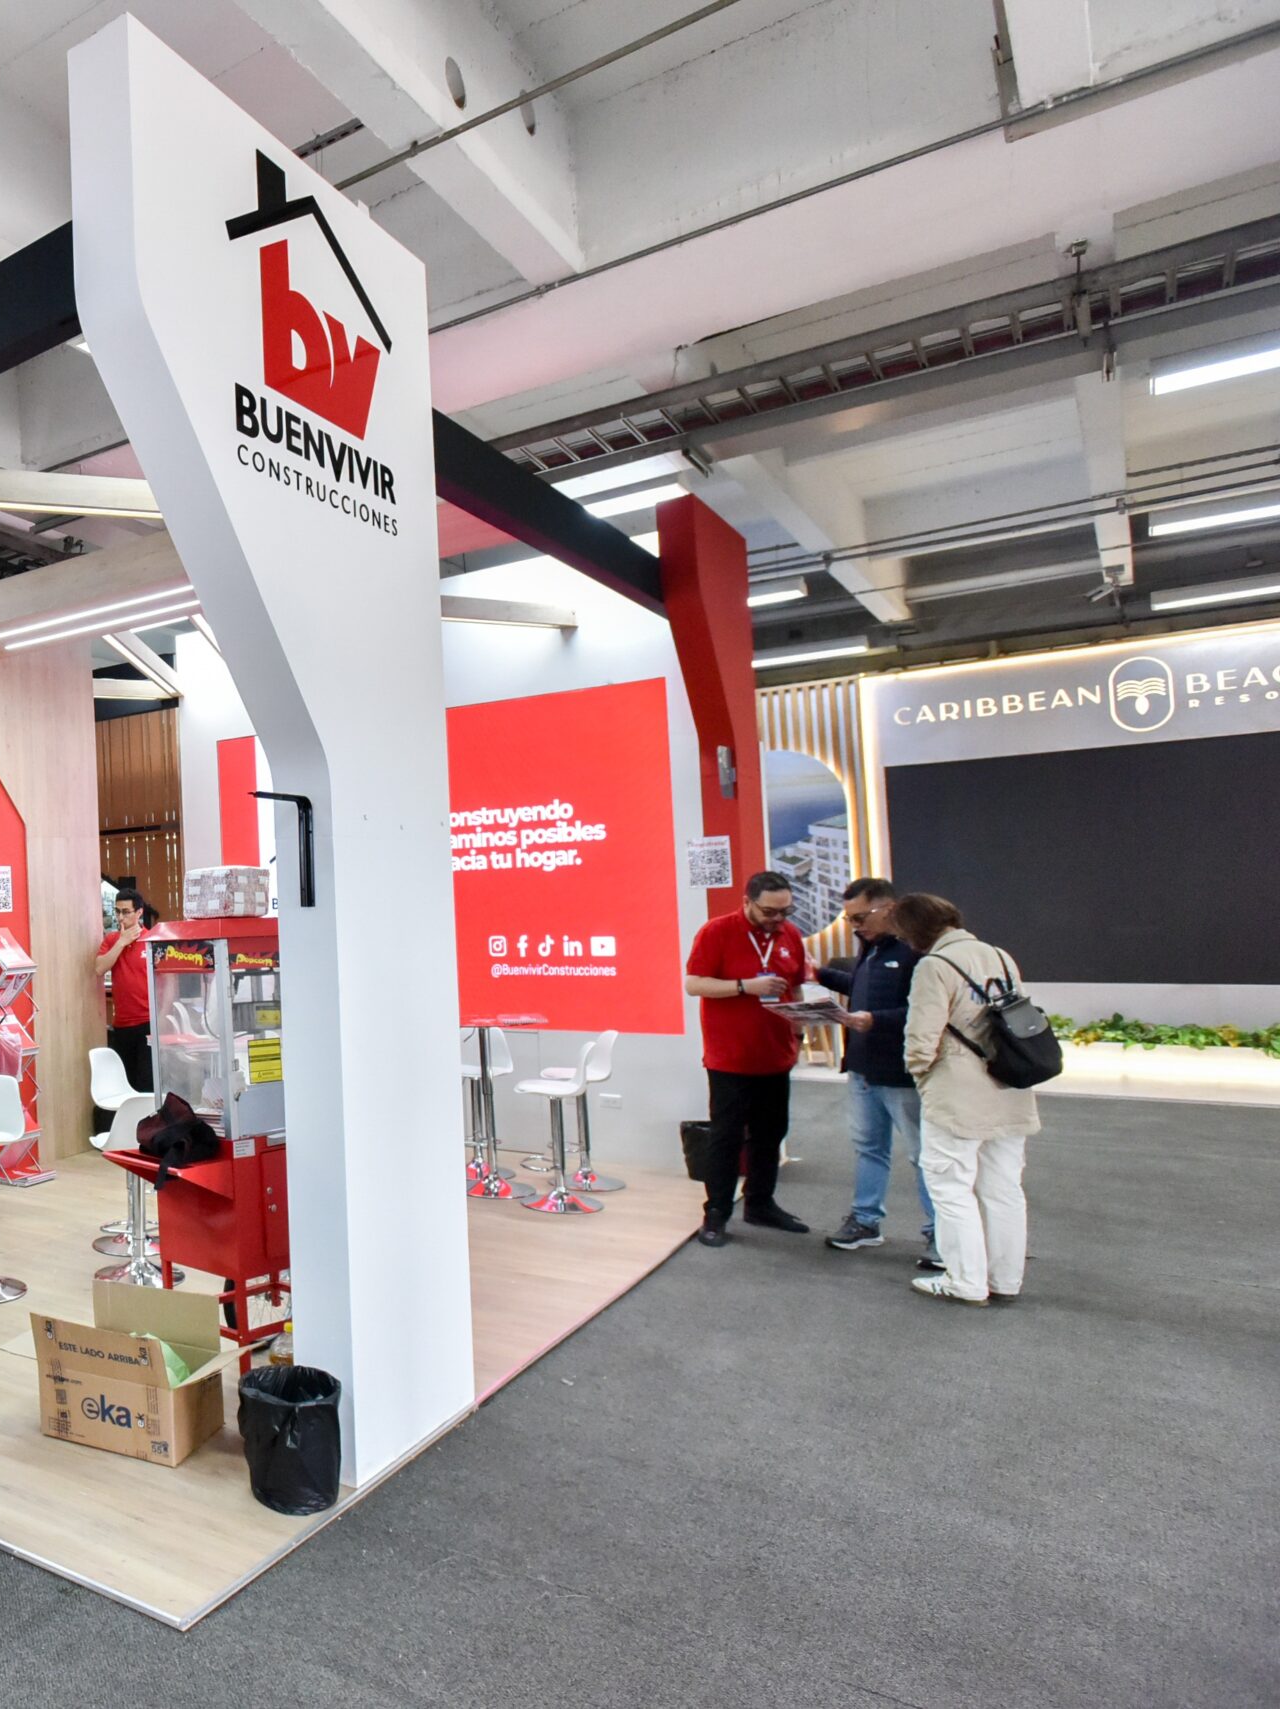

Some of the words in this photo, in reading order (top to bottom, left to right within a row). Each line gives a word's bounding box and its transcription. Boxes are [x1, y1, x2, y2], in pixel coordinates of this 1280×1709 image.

[234, 382, 397, 505] BUENVIVIR
[237, 444, 399, 537] CONSTRUCCIONES
[893, 684, 1102, 726] CARIBBEAN
[449, 799, 574, 828] onstruyendo
[450, 826, 518, 849] aminos
[520, 820, 607, 850] posibles
[451, 849, 488, 871] acia
[490, 851, 513, 870] tu
[516, 848, 583, 872] hogar.
[165, 944, 204, 967] Popcorn
[491, 963, 617, 978] @BuenvivirConstrucciones
[58, 1341, 78, 1353] ESTE
[80, 1346, 105, 1359] LADO
[108, 1352, 141, 1367] ARRIBA
[81, 1394, 132, 1429] eka
